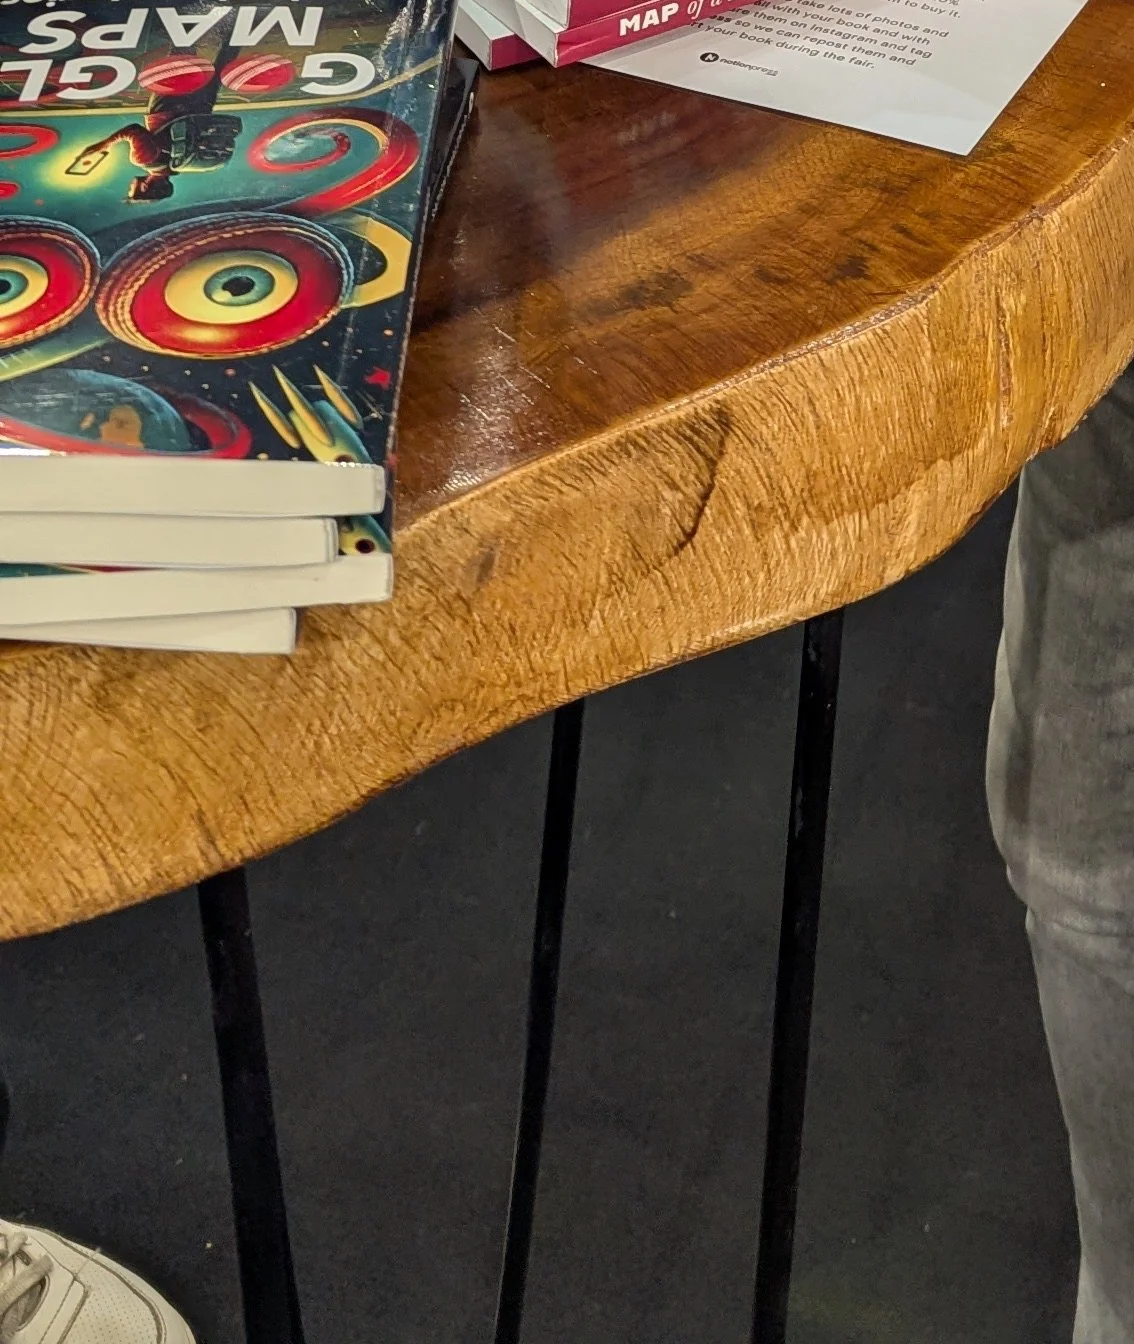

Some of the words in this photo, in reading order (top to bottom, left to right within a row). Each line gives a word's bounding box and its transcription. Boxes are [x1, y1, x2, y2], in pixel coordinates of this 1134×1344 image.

[619, 2, 679, 37] MAP
[773, 5, 802, 16] with
[803, 11, 835, 24] your
[836, 18, 870, 31] book
[872, 26, 900, 38] and
[901, 32, 931, 45] with
[827, 4, 853, 16] lots
[871, 15, 920, 32] photos
[922, 27, 950, 39] and
[905, 0, 918, 8] to
[920, 3, 947, 15] buy
[948, 9, 961, 19] it.
[18, 6, 324, 54] MAPS
[705, 25, 737, 37] your
[739, 31, 774, 45] book
[776, 42, 820, 58] during
[823, 51, 845, 62] the
[735, 20, 751, 28] so
[754, 24, 774, 33] we
[776, 29, 801, 40] can
[802, 35, 848, 51] repost
[851, 45, 886, 60] them
[888, 55, 917, 66] and
[753, 11, 788, 24] them
[790, 21, 807, 29] on
[810, 23, 878, 45] Instagram
[880, 41, 908, 52] and
[910, 47, 932, 59] tag
